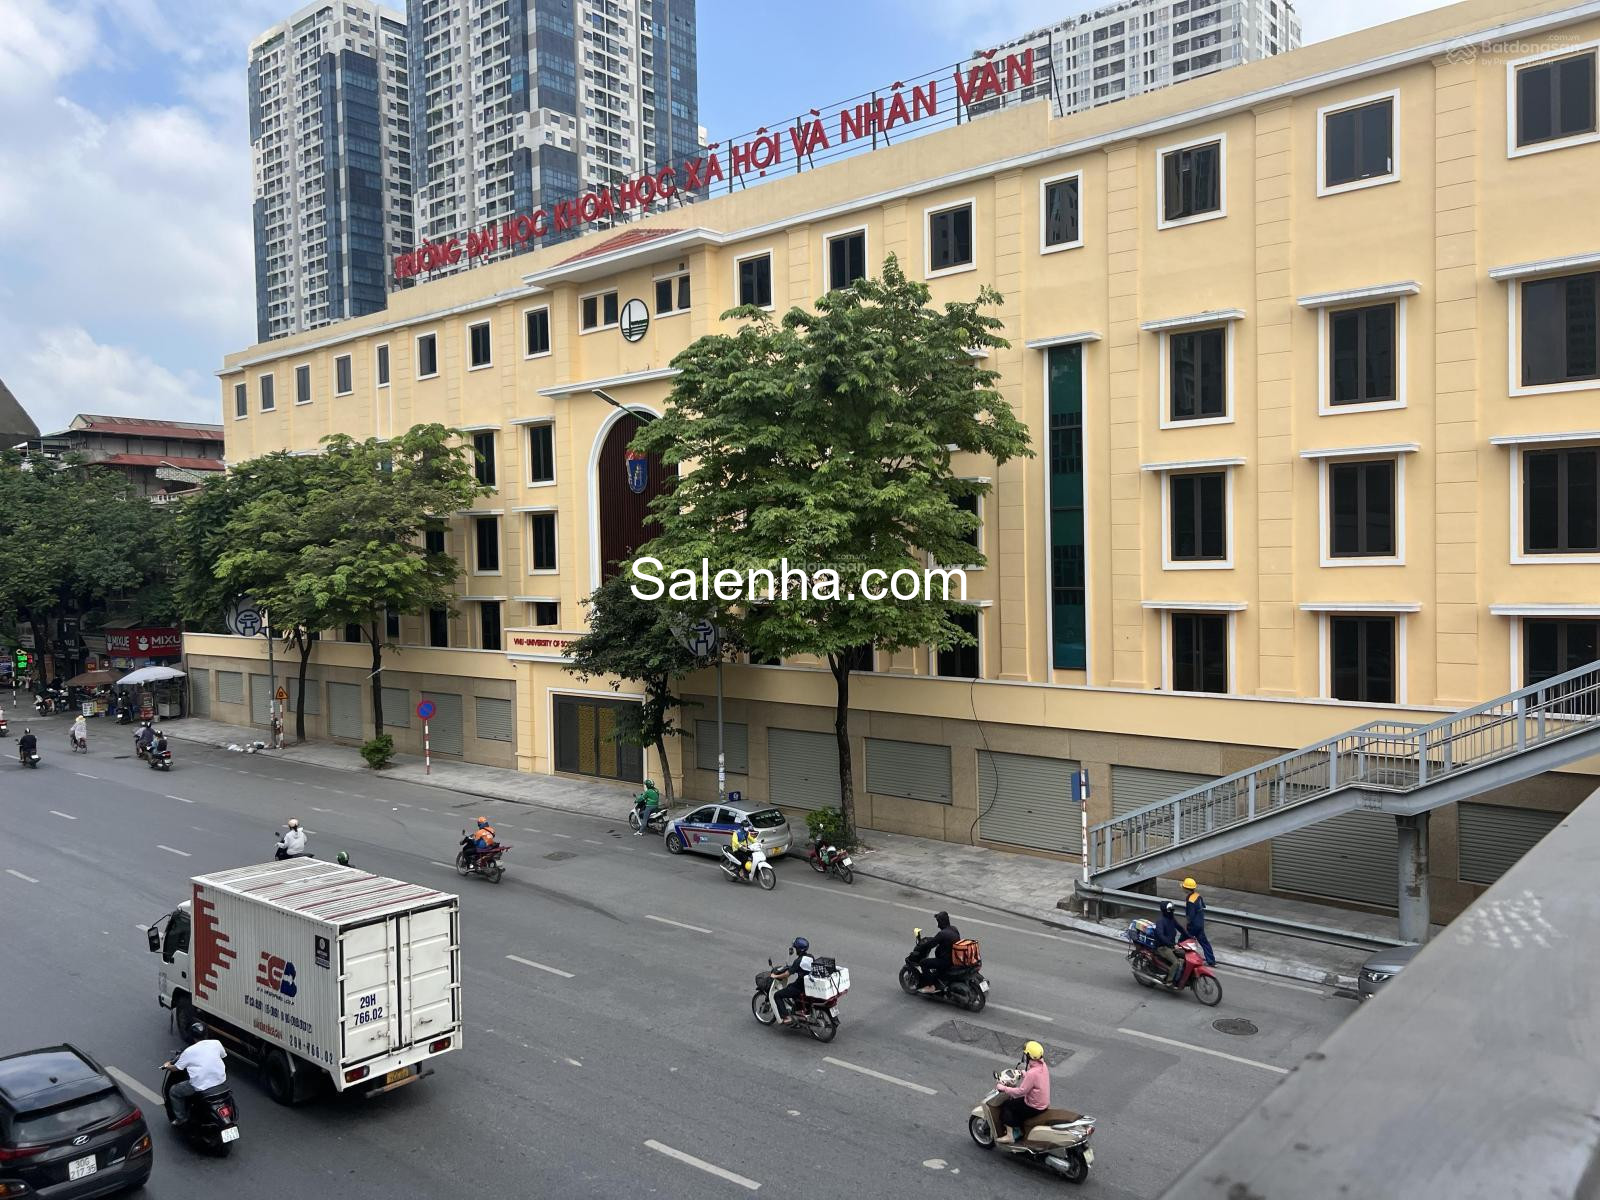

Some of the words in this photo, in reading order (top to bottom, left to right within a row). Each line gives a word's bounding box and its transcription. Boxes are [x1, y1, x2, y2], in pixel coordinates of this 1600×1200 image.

[466, 222, 498, 261] ĐẠI
[502, 209, 549, 249] HỌC
[553, 187, 616, 232] KHOA
[619, 165, 677, 213] HỌC
[683, 142, 724, 192] XÃ
[731, 126, 782, 178] HỘI
[789, 108, 830, 157] VÀ
[840, 80, 937, 144] NHÂN
[953, 48, 1035, 106] VĂN
[111, 635, 130, 647] MIXUE
[553, 640, 560, 648] OF
[360, 993, 376, 1009] 29H
[353, 1006, 383, 1026] 766.02
[75, 1157, 90, 1169] 30G
